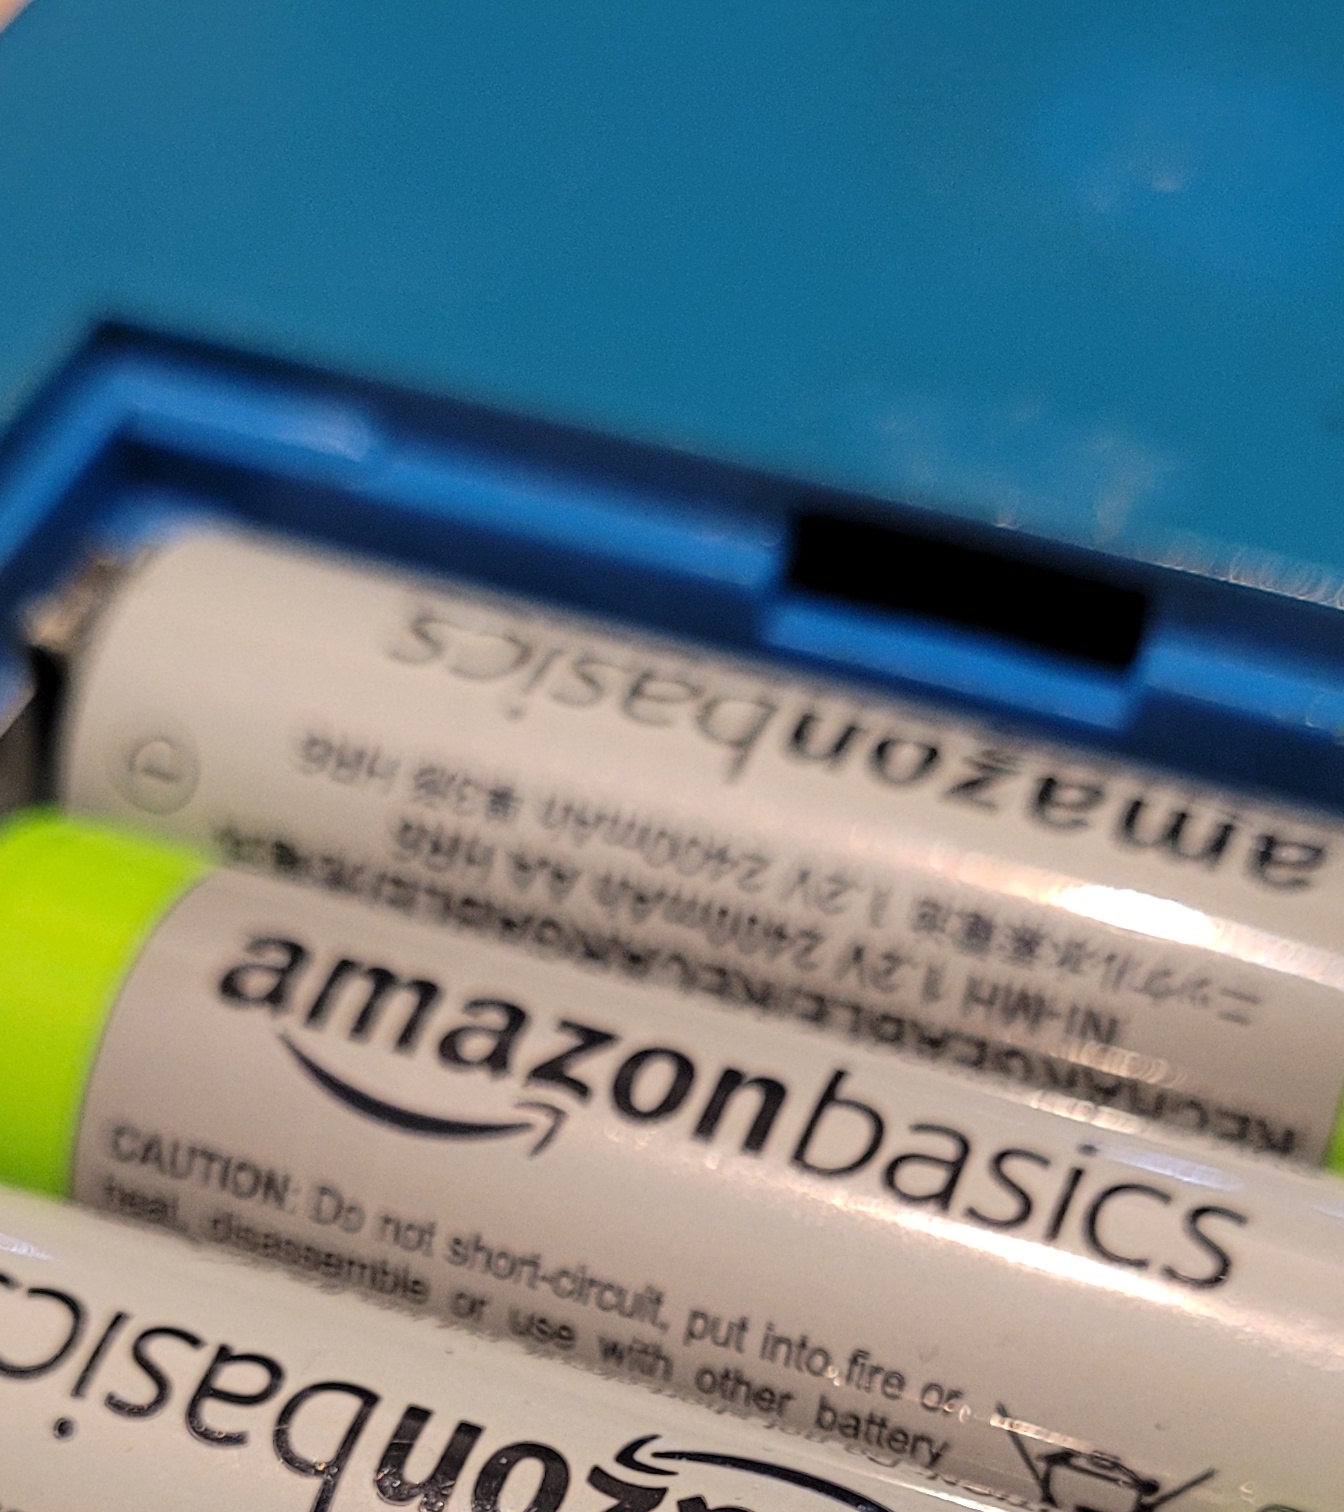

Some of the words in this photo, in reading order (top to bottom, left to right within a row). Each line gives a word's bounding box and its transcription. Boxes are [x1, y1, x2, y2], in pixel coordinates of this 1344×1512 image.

[388, 605, 1330, 890] amazonbasics
[509, 848, 575, 900] AA
[537, 793, 764, 892] 2400mAh
[592, 869, 825, 973] 2400mAh
[790, 874, 887, 929] 1.2V
[835, 945, 943, 1001] 1.2V
[218, 930, 1249, 1289] amazonbasics
[109, 1124, 297, 1214] CAUTION:
[312, 1185, 365, 1235] Do
[379, 1209, 435, 1254] not
[446, 1229, 670, 1331] short-circuit,
[685, 1301, 750, 1357] put
[760, 1324, 832, 1380] into
[845, 1347, 905, 1401] fire
[921, 1378, 963, 1417] or
[454, 1290, 485, 1322] or
[508, 1302, 577, 1350] use
[597, 1327, 674, 1384] with
[694, 1359, 794, 1419] other
[815, 1394, 951, 1472] battery
